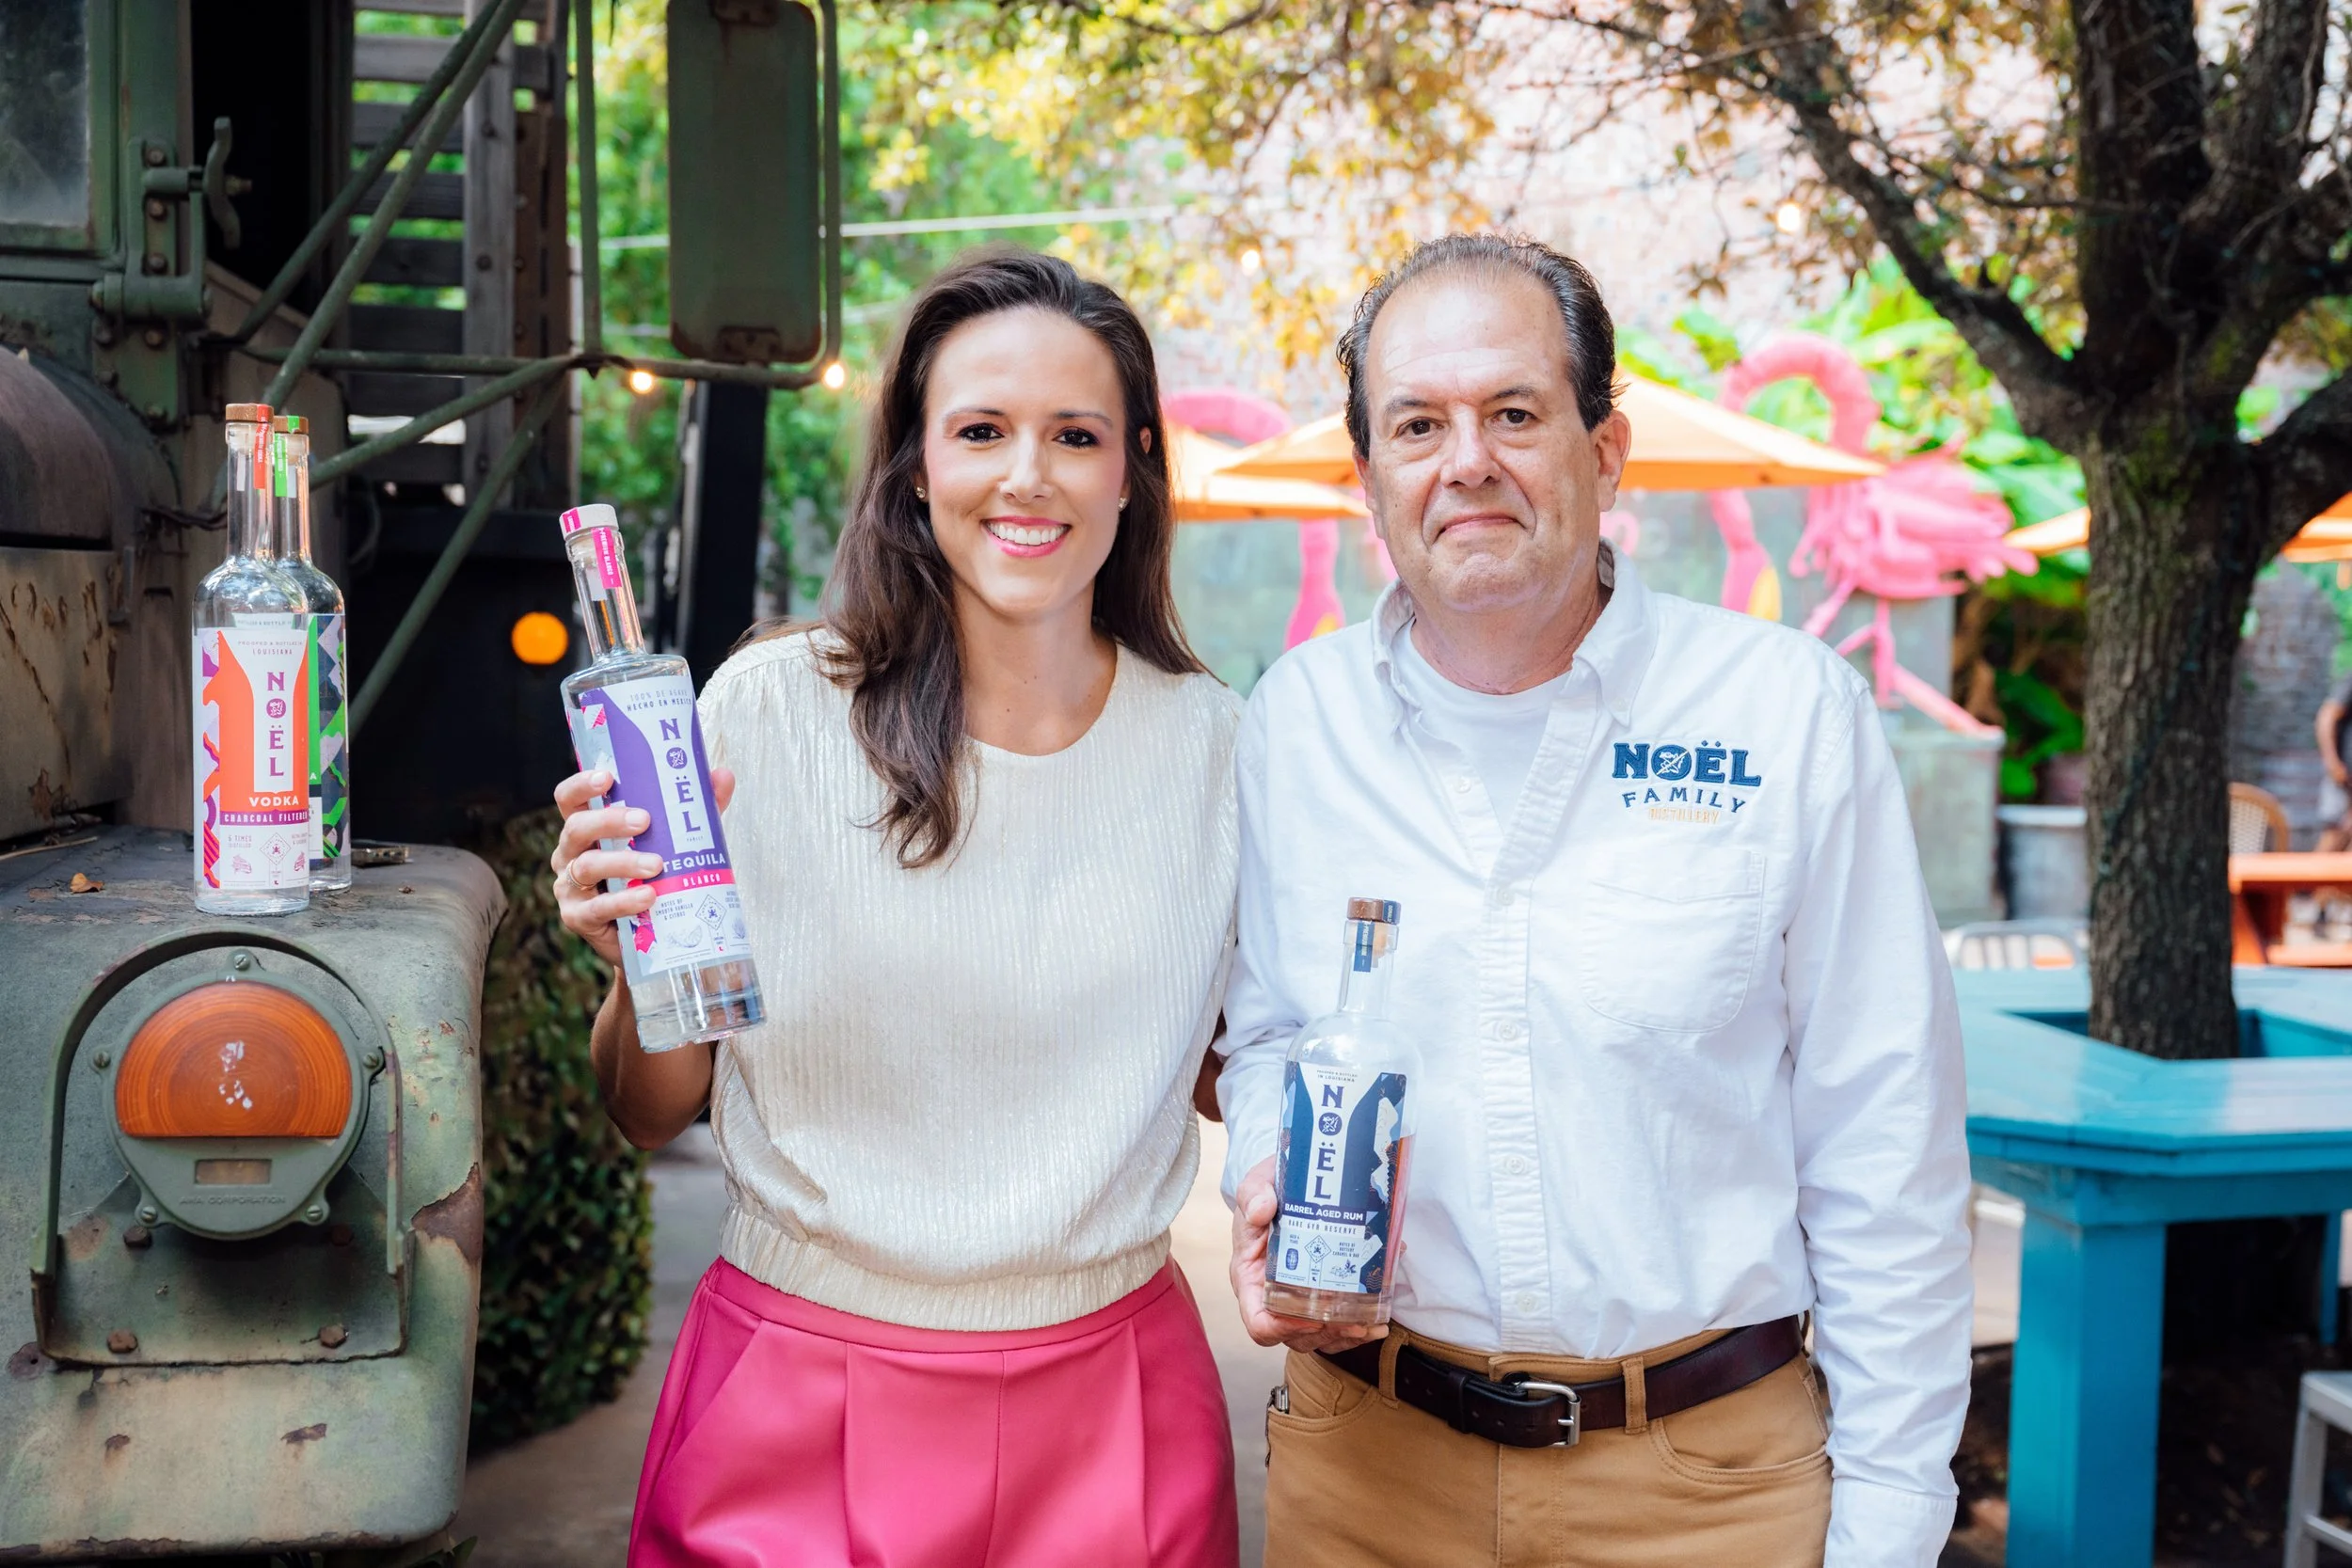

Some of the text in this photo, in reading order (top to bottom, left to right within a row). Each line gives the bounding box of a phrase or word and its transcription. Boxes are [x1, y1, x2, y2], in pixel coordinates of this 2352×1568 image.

[627, 701, 654, 712] HECHO
[1612, 739, 1762, 787] NOËL
[248, 796, 299, 807] VODKA
[1621, 786, 1746, 814] FAMILY
[224, 814, 274, 823] CHARCOAL
[1648, 807, 1721, 825] DISTILLERY
[662, 853, 726, 873] TEQUILA
[682, 873, 721, 887] BLANCO
[208, 1195, 286, 1206] CORPORATION
[1284, 1203, 1363, 1221] BARREL AGED RUM
[1325, 1225, 1357, 1234] RESERVE
